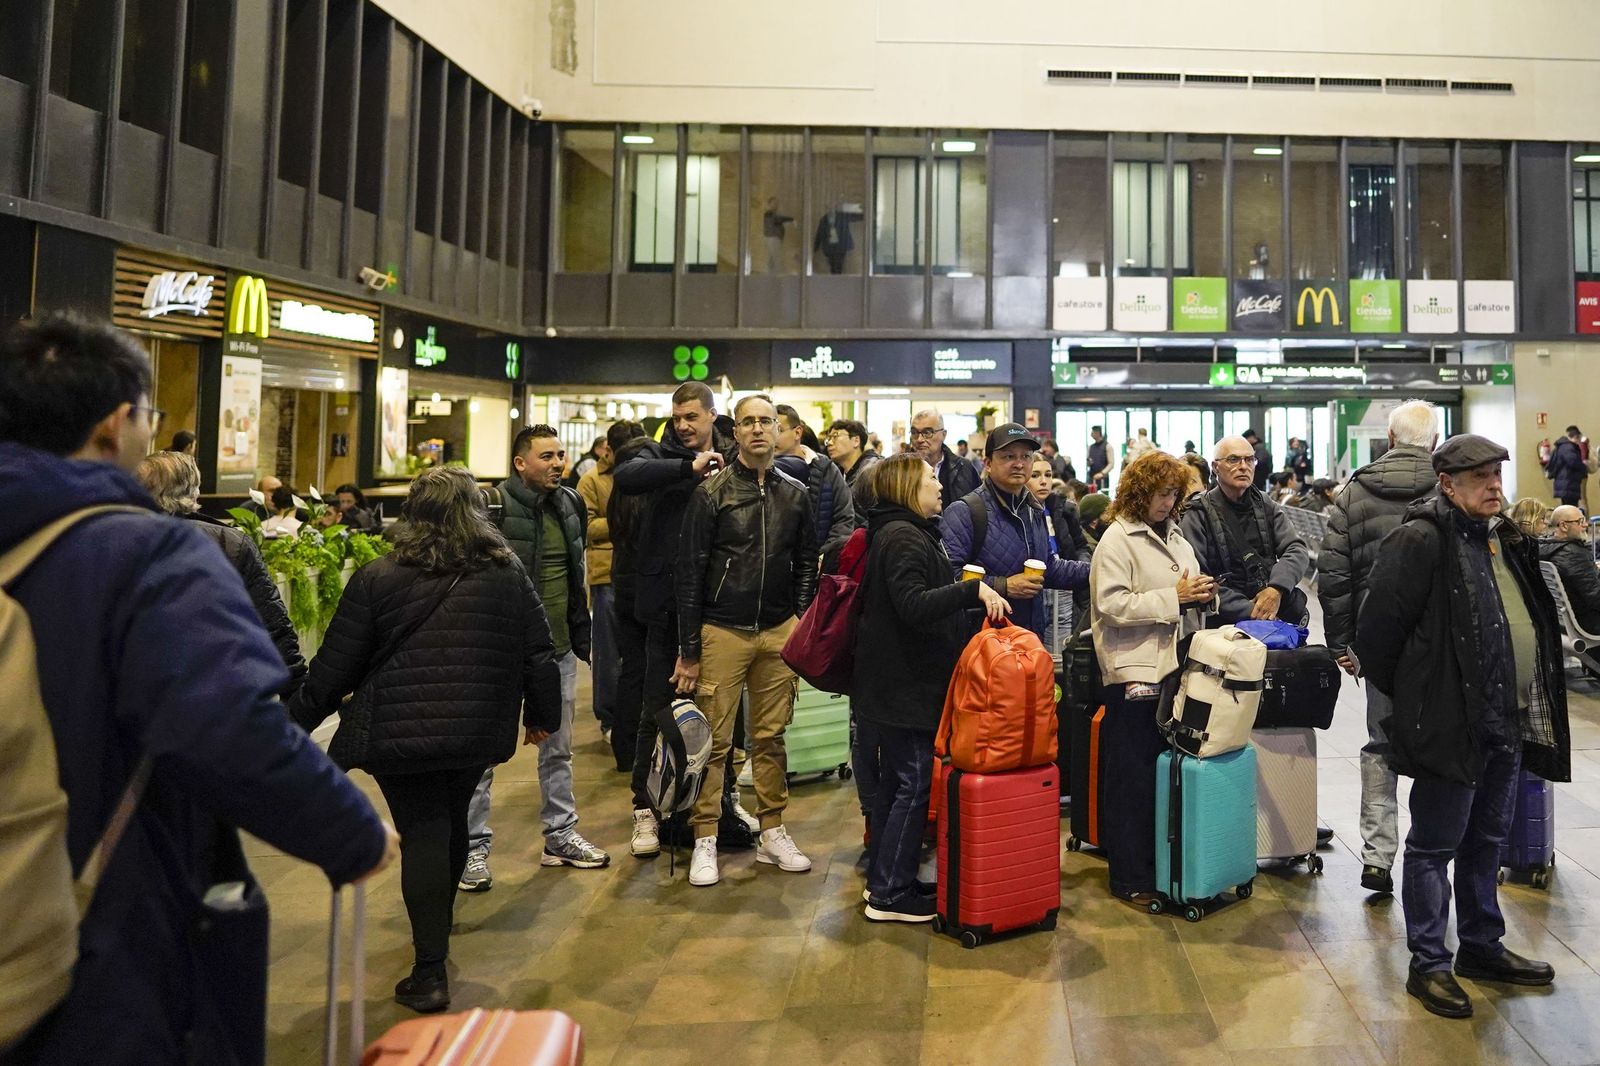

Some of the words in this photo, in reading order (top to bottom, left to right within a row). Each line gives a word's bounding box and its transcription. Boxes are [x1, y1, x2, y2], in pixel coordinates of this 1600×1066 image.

[1057, 299, 1103, 309] cafestore
[1579, 297, 1599, 306] AVIS
[1119, 301, 1162, 314] Deliquo
[1181, 304, 1218, 314] tiendas
[1356, 306, 1393, 316] tiendas
[1413, 303, 1453, 316] Deliquo
[1467, 302, 1511, 312] cafestore
[790, 357, 855, 377] Deliquo
